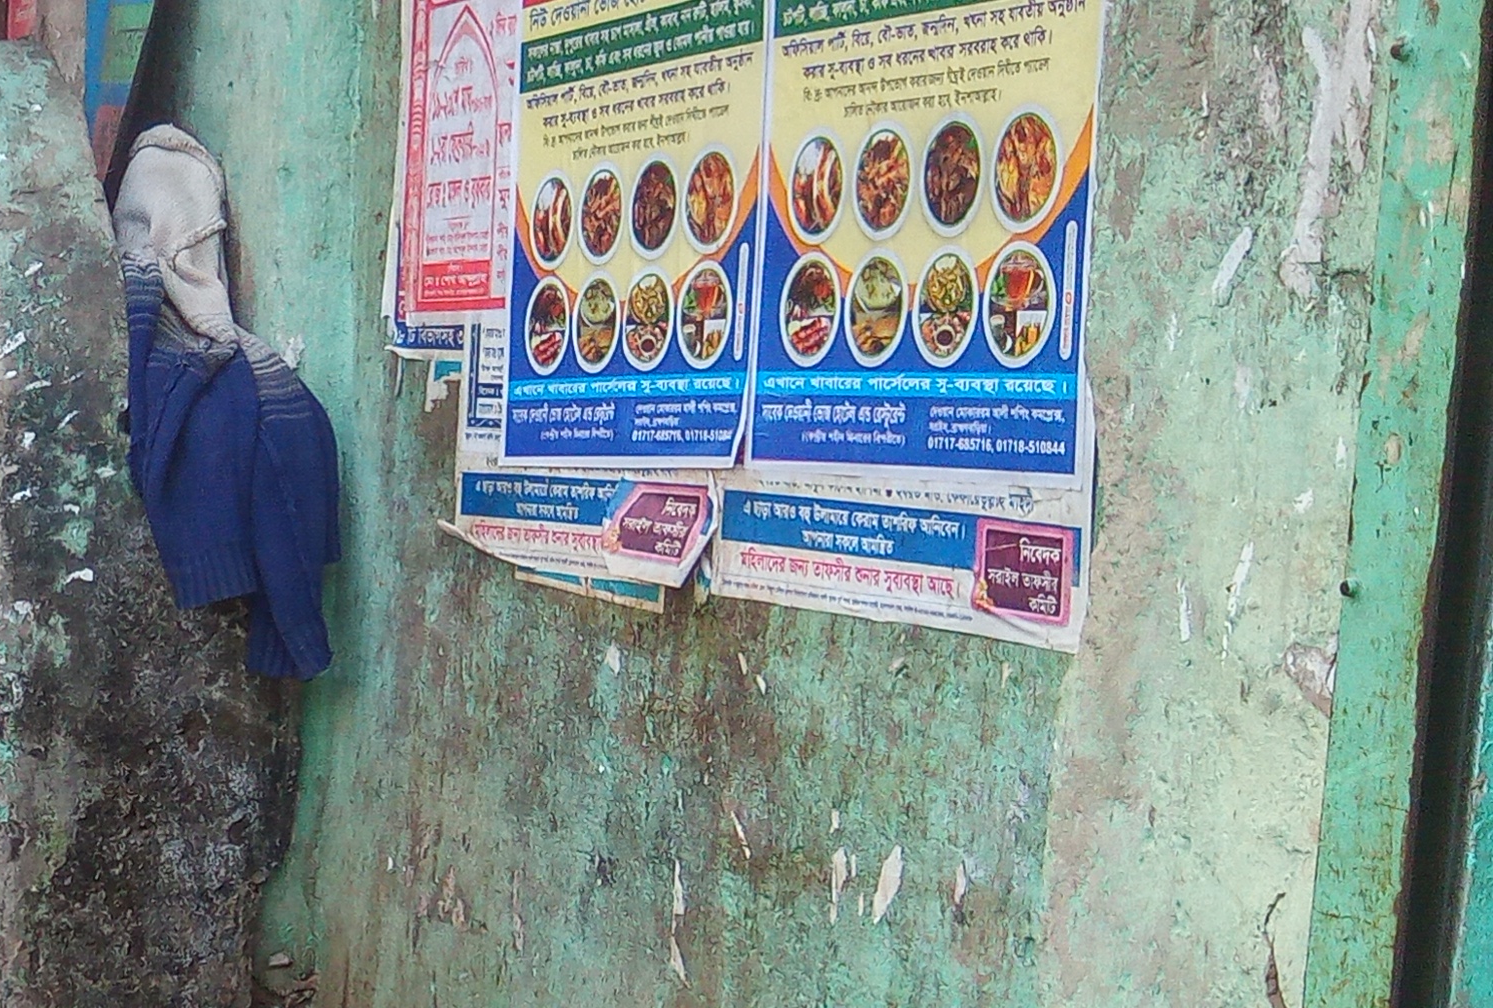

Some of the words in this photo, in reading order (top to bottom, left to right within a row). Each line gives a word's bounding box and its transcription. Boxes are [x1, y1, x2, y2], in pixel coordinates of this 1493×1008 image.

[764, 376, 805, 391] এখানে
[809, 376, 862, 391] খাবারের
[868, 373, 931, 391] পার্সেলের
[937, 376, 999, 395] সু-ব্যবস্থা
[1019, 537, 1062, 564] নিবেদক
[740, 550, 786, 573] মহিলাদের
[789, 557, 808, 578] জন্য
[812, 556, 851, 582] তাফসীর
[884, 565, 924, 594] সুব্যবস্থা
[987, 566, 1019, 588] সরাইল
[1021, 567, 1059, 594] তাফসীর
[1028, 595, 1058, 615] কমিটি
